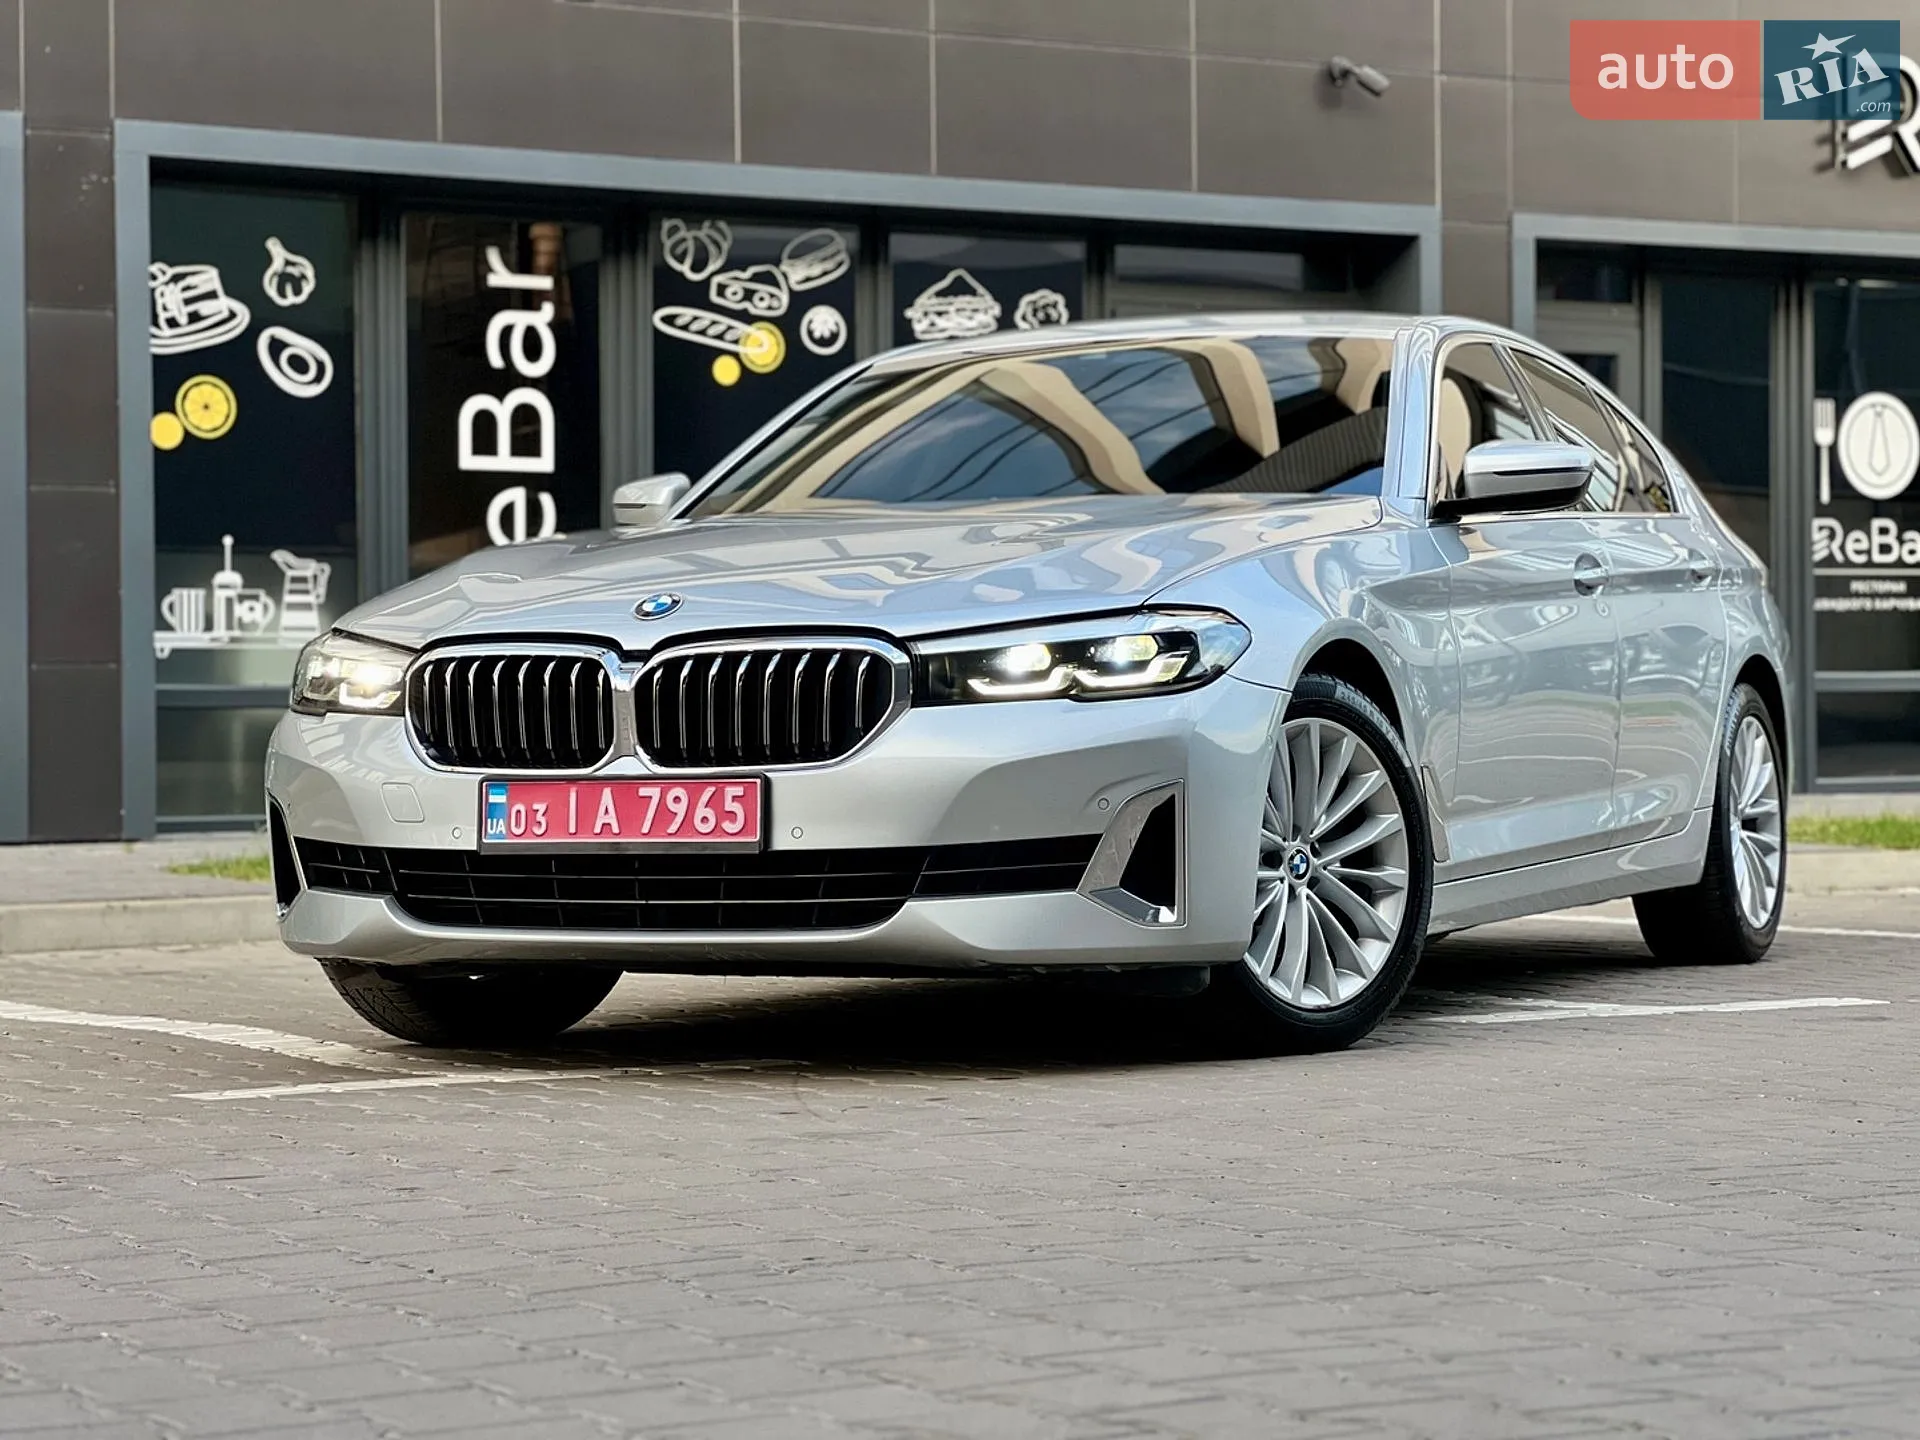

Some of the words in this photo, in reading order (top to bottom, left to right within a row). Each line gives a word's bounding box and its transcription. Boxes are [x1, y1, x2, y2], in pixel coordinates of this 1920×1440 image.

[487, 818, 507, 835] UA
[510, 802, 549, 836] 03
[637, 785, 746, 835] 7965
